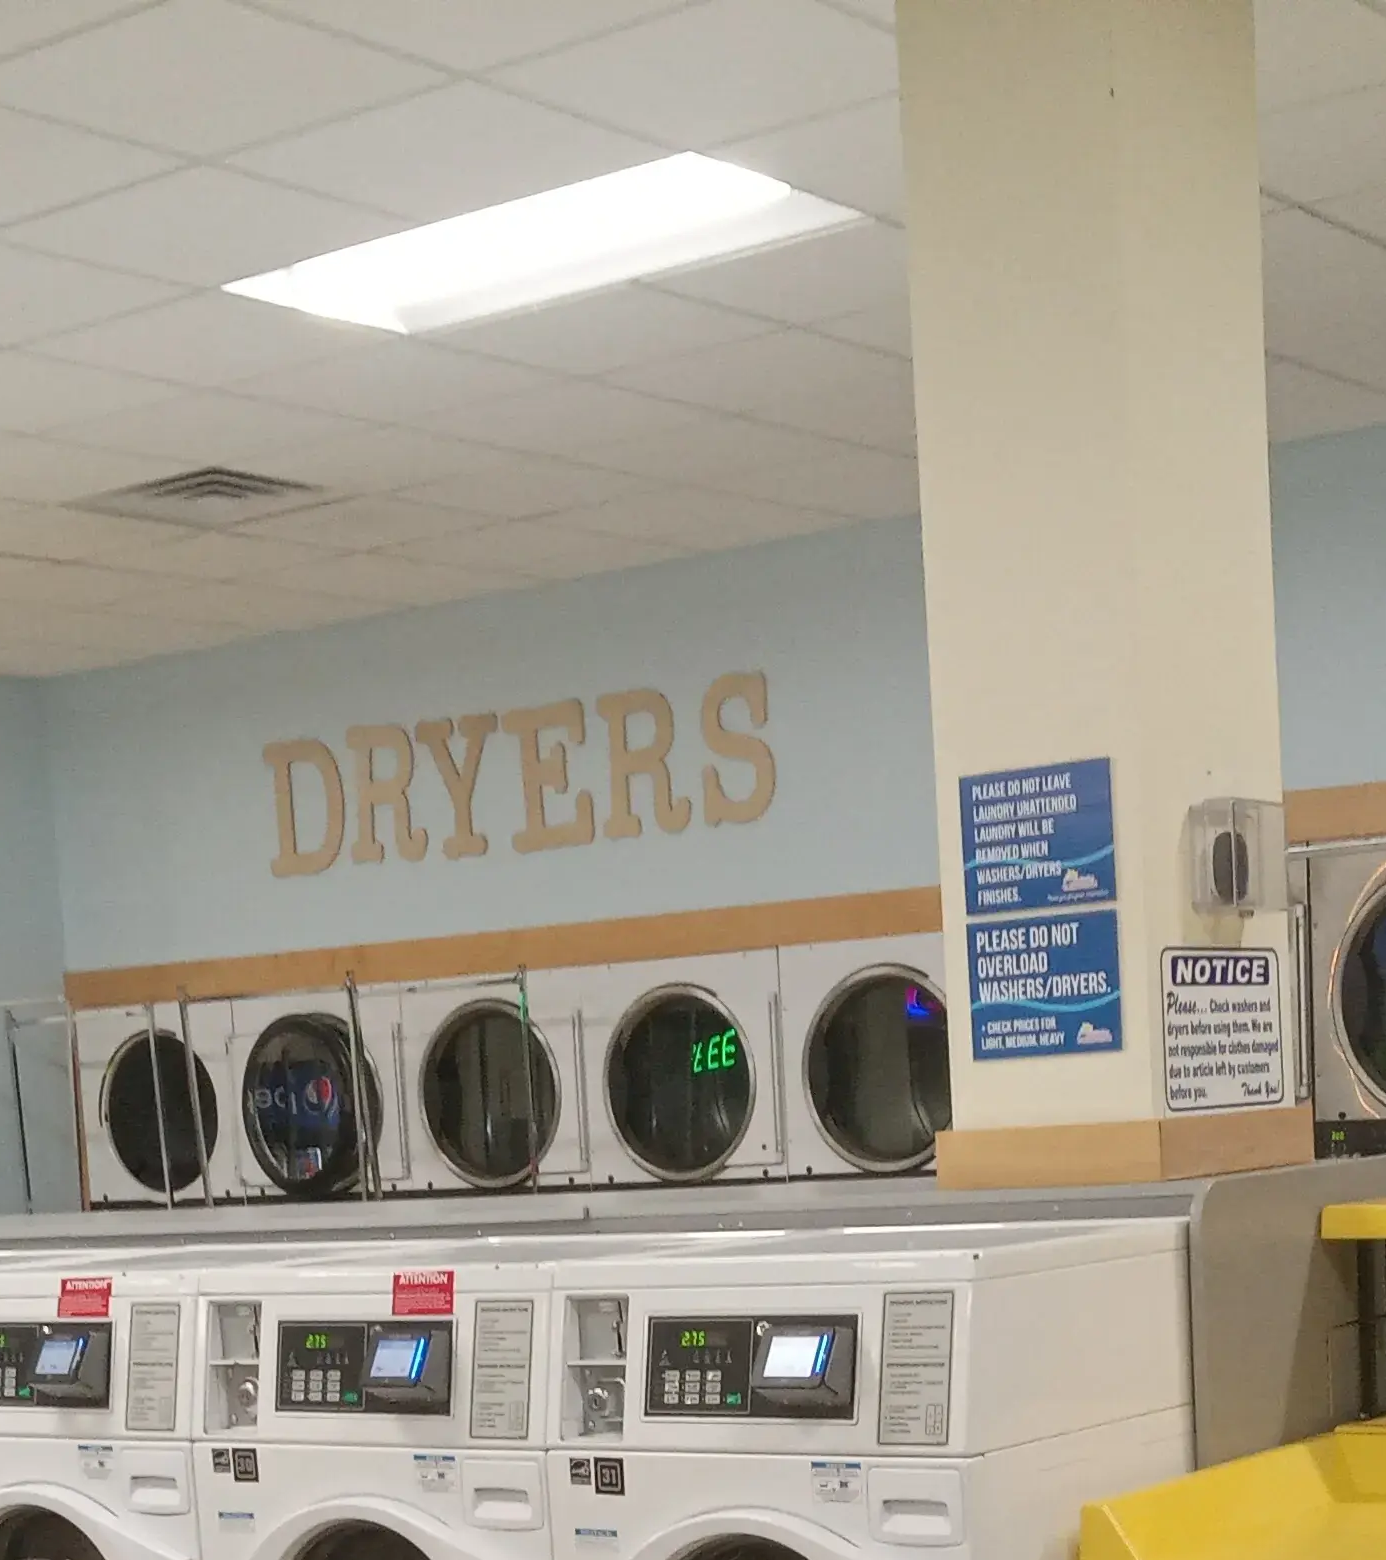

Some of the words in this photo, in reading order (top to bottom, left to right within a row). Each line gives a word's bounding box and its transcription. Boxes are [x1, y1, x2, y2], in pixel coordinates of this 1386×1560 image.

[262, 670, 777, 878] DRYERS
[972, 781, 1006, 801] PLEASE
[1007, 780, 1020, 795] DO
[1022, 777, 1041, 795] NOT
[1042, 772, 1071, 791] LEAVE
[973, 802, 1017, 822] LAUNDRY
[1017, 794, 1077, 816] UNATTENDED
[974, 822, 1018, 843] LAUNDRY
[1018, 819, 1040, 838] WILL
[1042, 817, 1055, 834] BE
[975, 845, 1019, 864] REMOVED
[1021, 840, 1048, 859] WHEN
[976, 860, 1062, 885] WASHERS/DRYERS
[976, 927, 1027, 953] PLEASE
[1029, 925, 1048, 949] DO
[1051, 922, 1079, 947] NOT
[977, 951, 1048, 979] OVERLOAD
[1176, 958, 1265, 984] NOTICE
[978, 971, 1111, 1004] WASHERS/DRYERS.
[1209, 998, 1230, 1013] Check
[1231, 998, 1258, 1013] washers
[1259, 998, 1271, 1012] and
[987, 1018, 1012, 1035] CHECK
[1013, 1017, 1039, 1032] PRICES
[1041, 1016, 1056, 1031] FOR
[1167, 1021, 1189, 1040] dryers
[1190, 1019, 1211, 1035] before
[1213, 1020, 1231, 1037] using
[1251, 1019, 1261, 1032] We
[1262, 1021, 1273, 1033] are
[1039, 1031, 1065, 1046] HEAVY
[1168, 1045, 1179, 1058] not
[1180, 1041, 1217, 1059] responsible
[1218, 1040, 1227, 1055] for
[1228, 1041, 1251, 1055] clothes
[1251, 1039, 1279, 1056] damaged
[1169, 1064, 1182, 1079] due
[1183, 1064, 1191, 1078] to
[1215, 1060, 1227, 1075] left
[1228, 1061, 1236, 1078] by
[1237, 1061, 1270, 1075] customers
[1169, 1084, 1192, 1100] before
[399, 1271, 449, 1285] ATTENTION
[602, 1467, 617, 1485] 31
